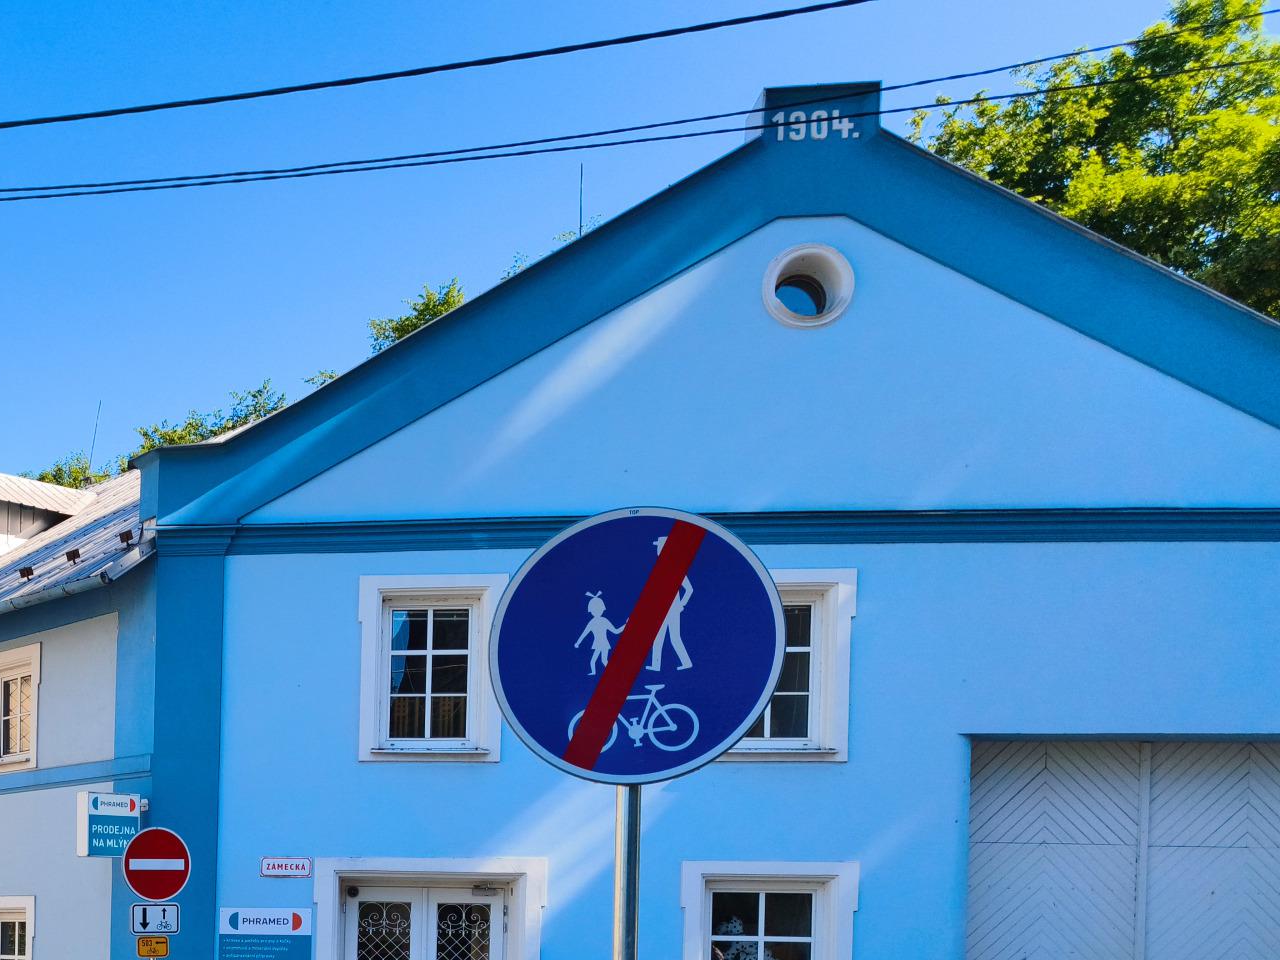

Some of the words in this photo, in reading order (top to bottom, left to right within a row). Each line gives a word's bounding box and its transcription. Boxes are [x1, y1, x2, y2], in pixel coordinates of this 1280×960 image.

[100, 800, 129, 808] PHRAMED
[91, 824, 136, 835] PRODEJNA
[92, 838, 105, 847] NA
[242, 917, 290, 926] PHRAMED
